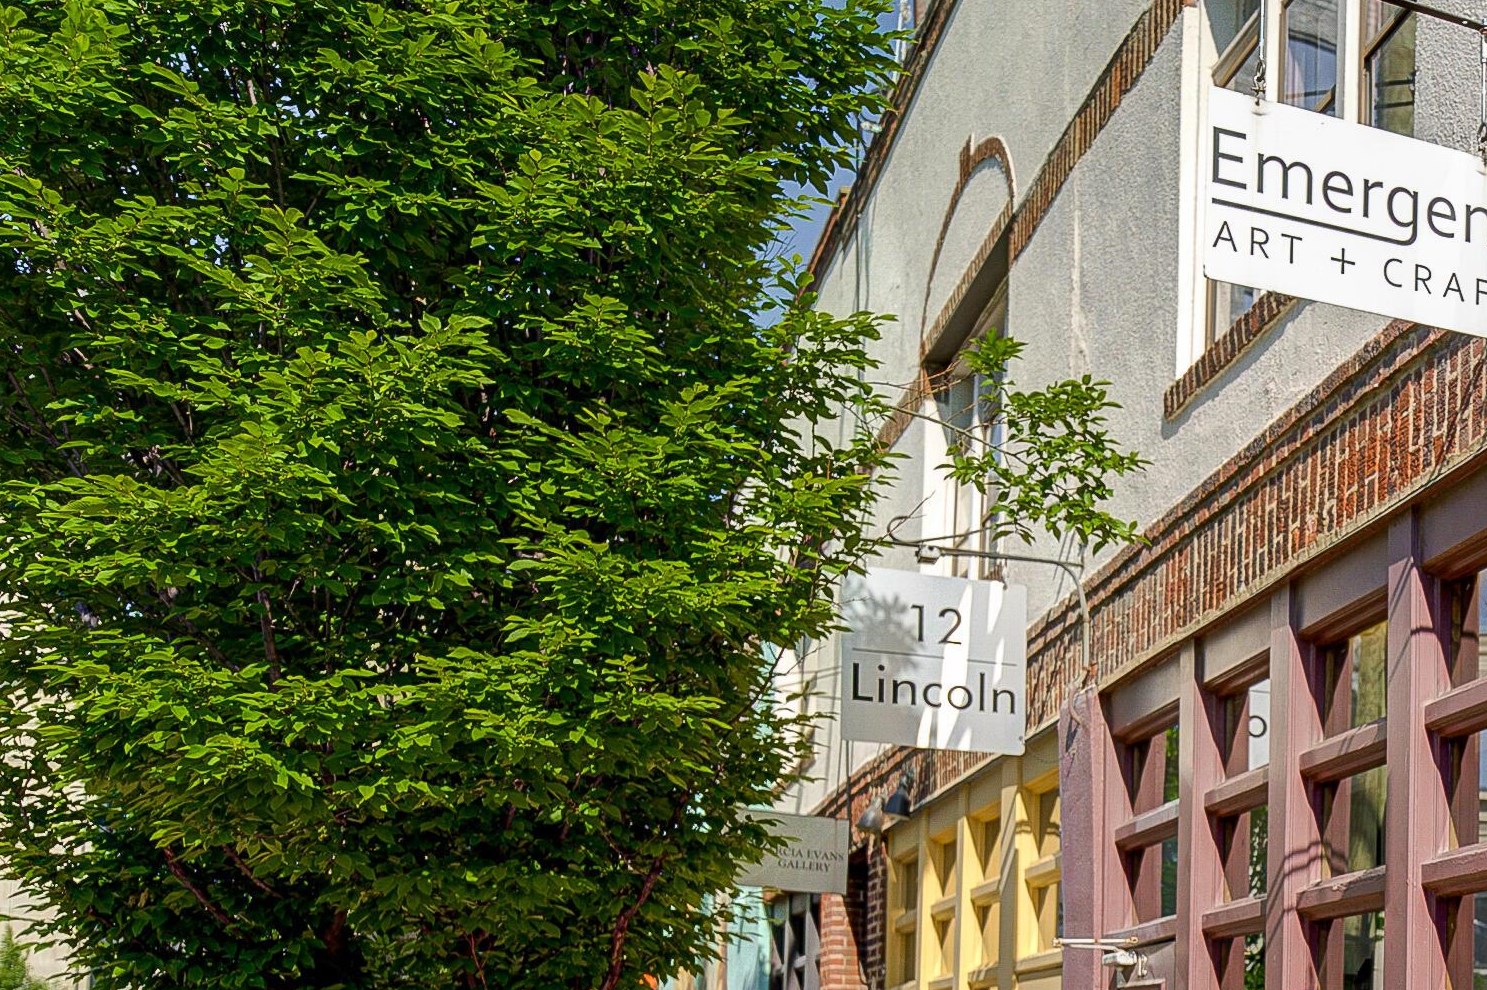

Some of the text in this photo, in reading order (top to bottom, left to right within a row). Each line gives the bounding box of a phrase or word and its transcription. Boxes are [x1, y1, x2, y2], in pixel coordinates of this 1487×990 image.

[1212, 220, 1303, 264] ART
[1330, 247, 1356, 275] +
[910, 604, 963, 645] 12
[852, 662, 1016, 715] Lincoln
[778, 859, 831, 872] GALLERY
[807, 848, 844, 861] EVANS
